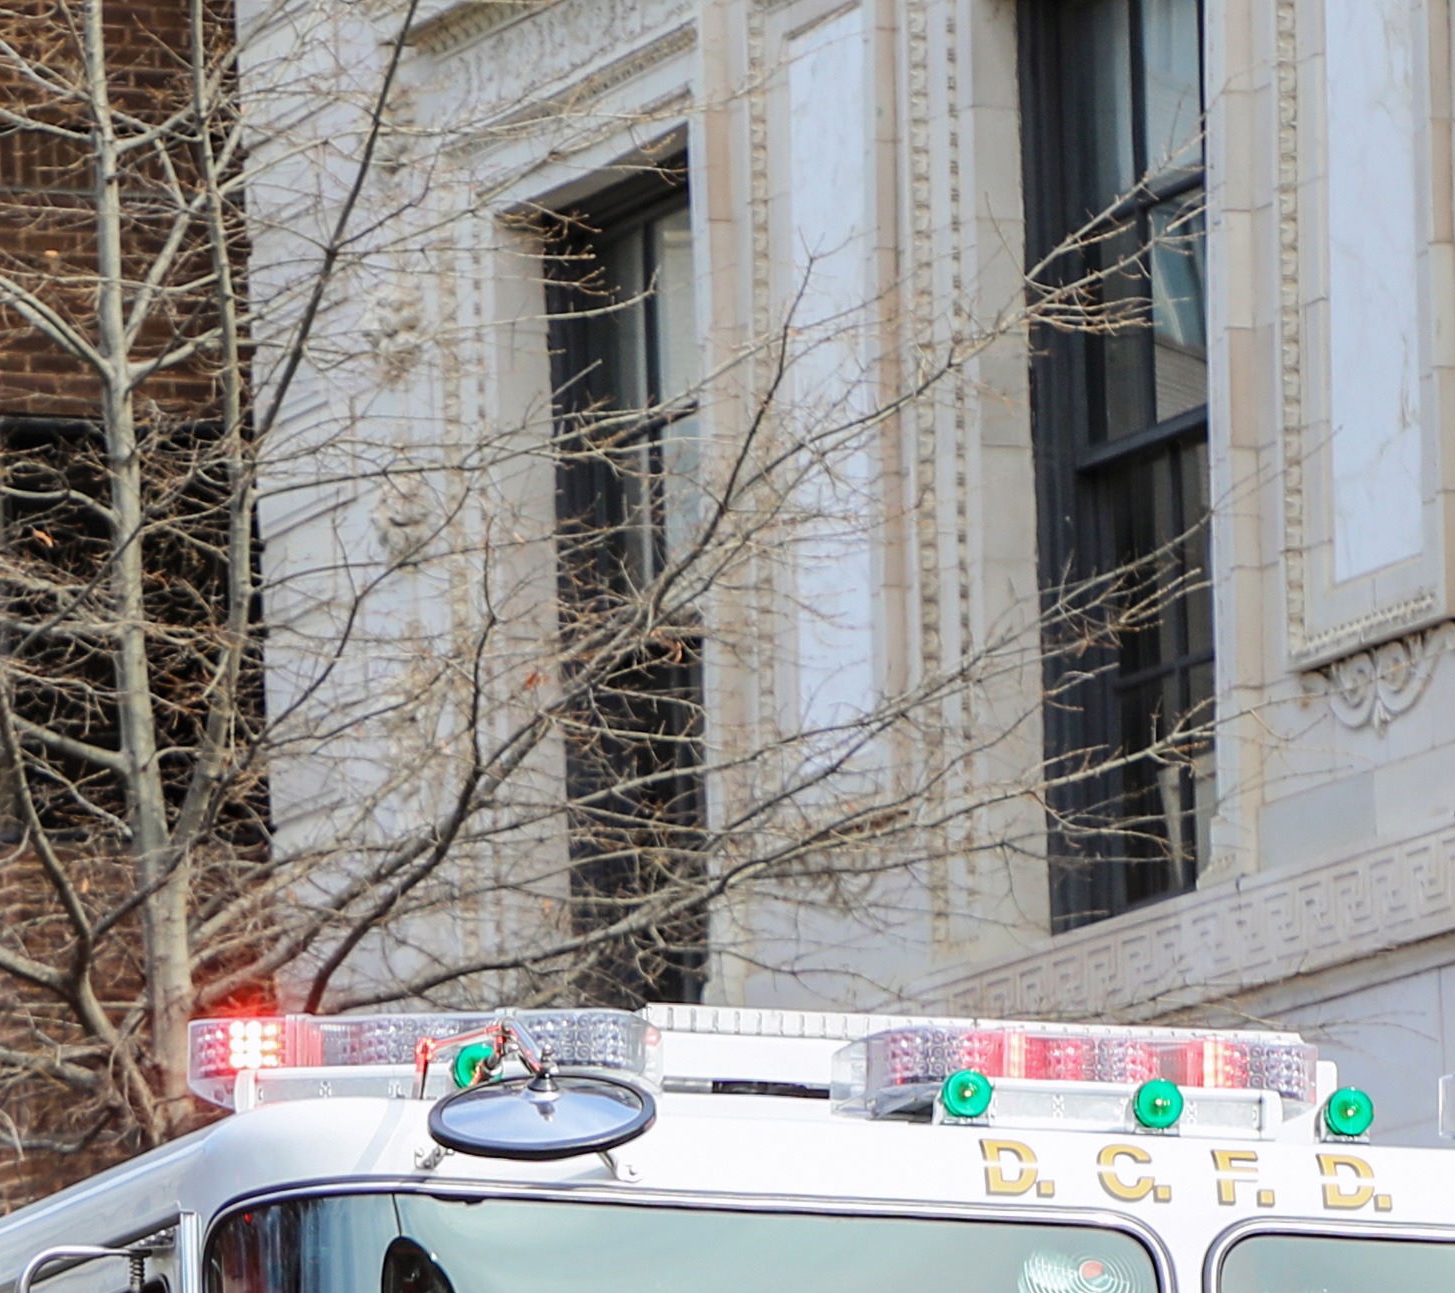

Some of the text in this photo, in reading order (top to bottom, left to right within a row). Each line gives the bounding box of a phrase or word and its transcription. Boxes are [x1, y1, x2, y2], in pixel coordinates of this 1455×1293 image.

[979, 1138, 1393, 1212] D. C. F. D.
